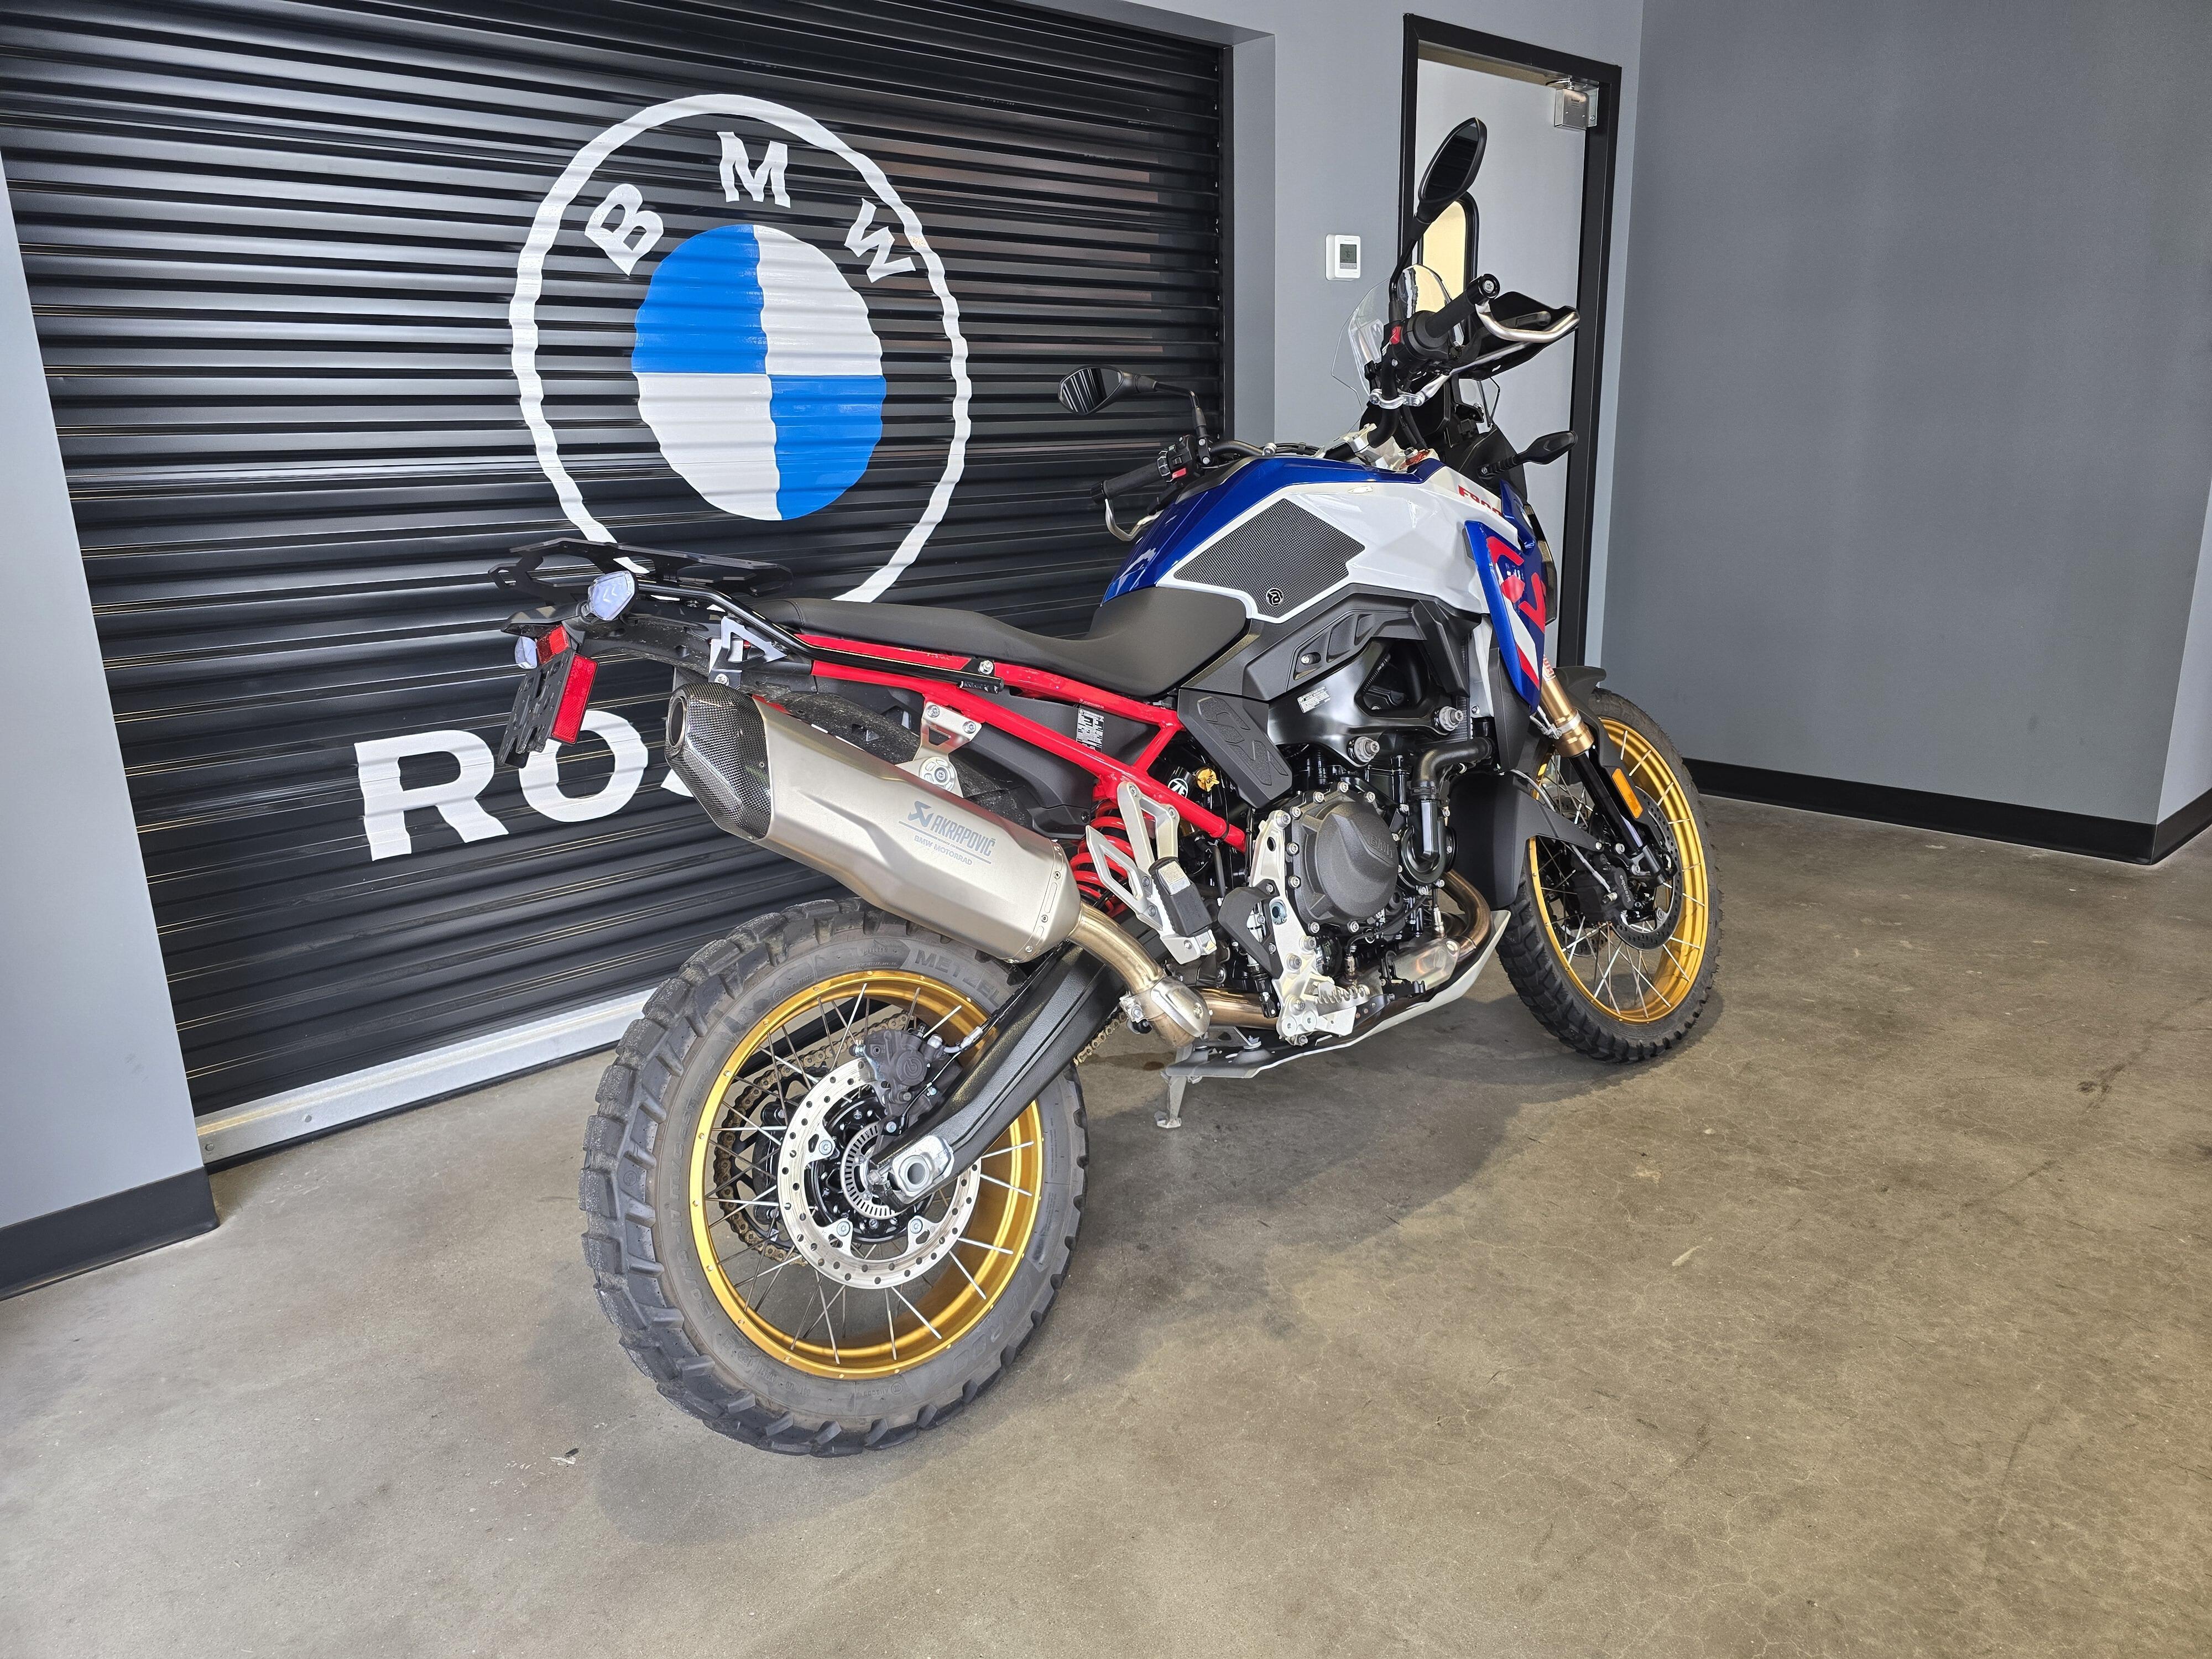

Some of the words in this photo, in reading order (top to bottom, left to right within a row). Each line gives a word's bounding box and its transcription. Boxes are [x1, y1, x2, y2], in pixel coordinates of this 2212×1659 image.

[585, 132, 916, 283] BMW
[354, 710, 692, 862] RO
[914, 835, 933, 847] BMW
[933, 843, 973, 865] MOTORRAD
